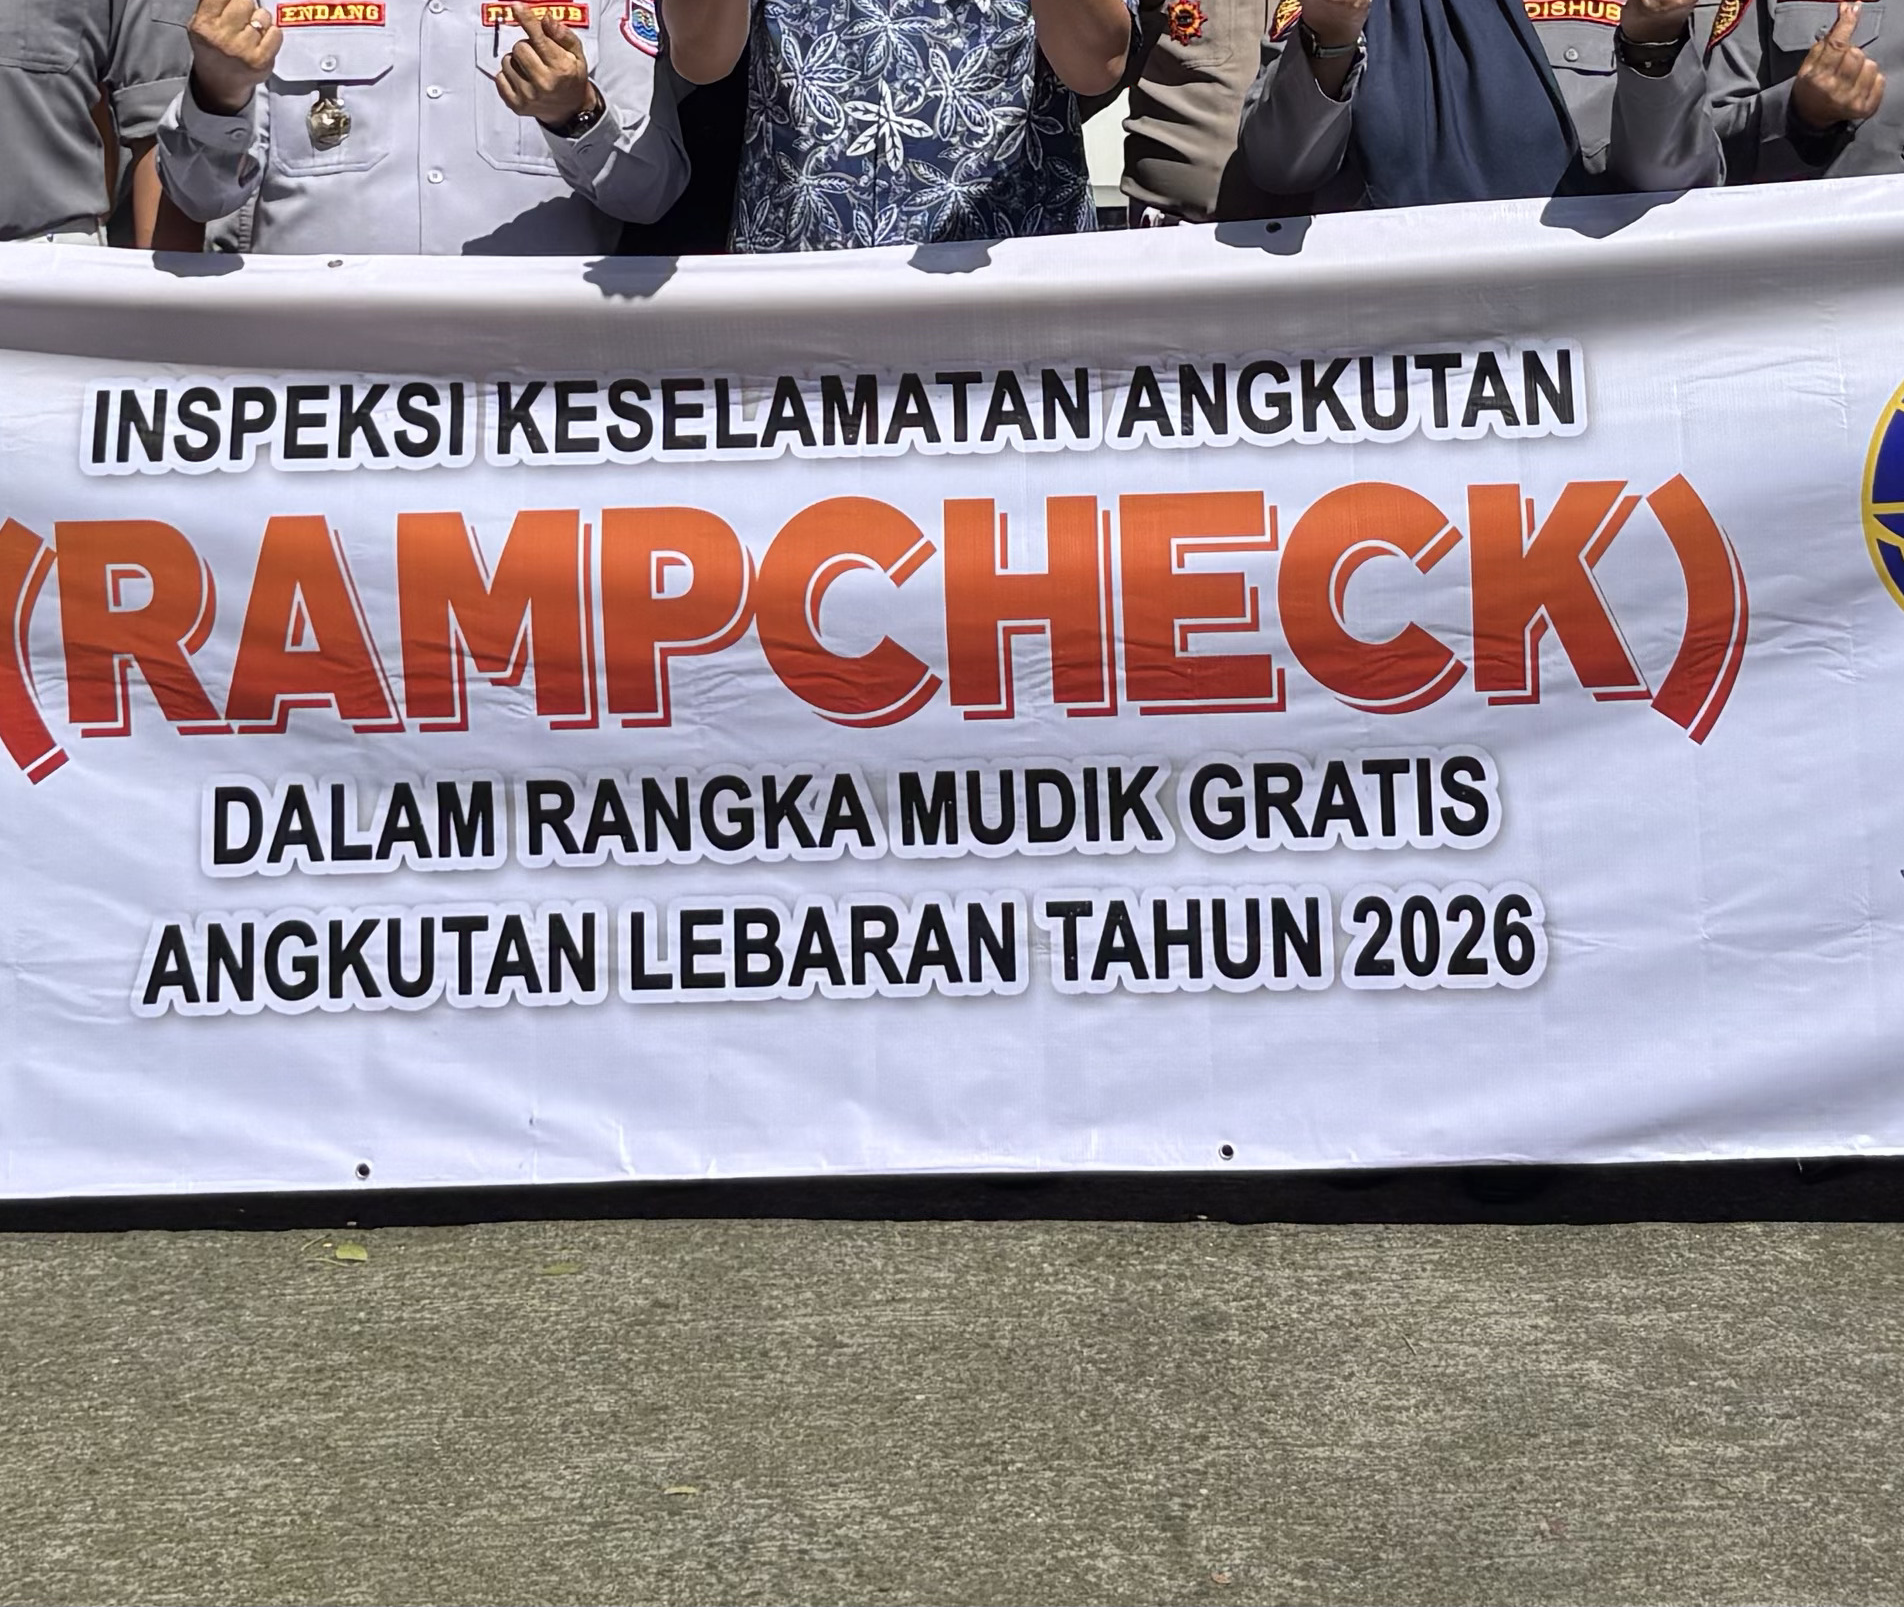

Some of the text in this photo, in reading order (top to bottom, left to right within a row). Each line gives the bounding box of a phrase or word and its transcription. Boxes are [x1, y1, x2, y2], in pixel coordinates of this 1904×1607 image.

[280, 4, 381, 24] ENDANG
[1526, 0, 1621, 21] DISHUB
[91, 347, 1577, 465] INSPEKSI KESELAMATAN ANGKUTAN
[214, 754, 1490, 867] DALAM RANGKA MUDIK GRATIS
[142, 893, 1536, 1007] ANGKUTAN LEBARAN TAHUN 2026
